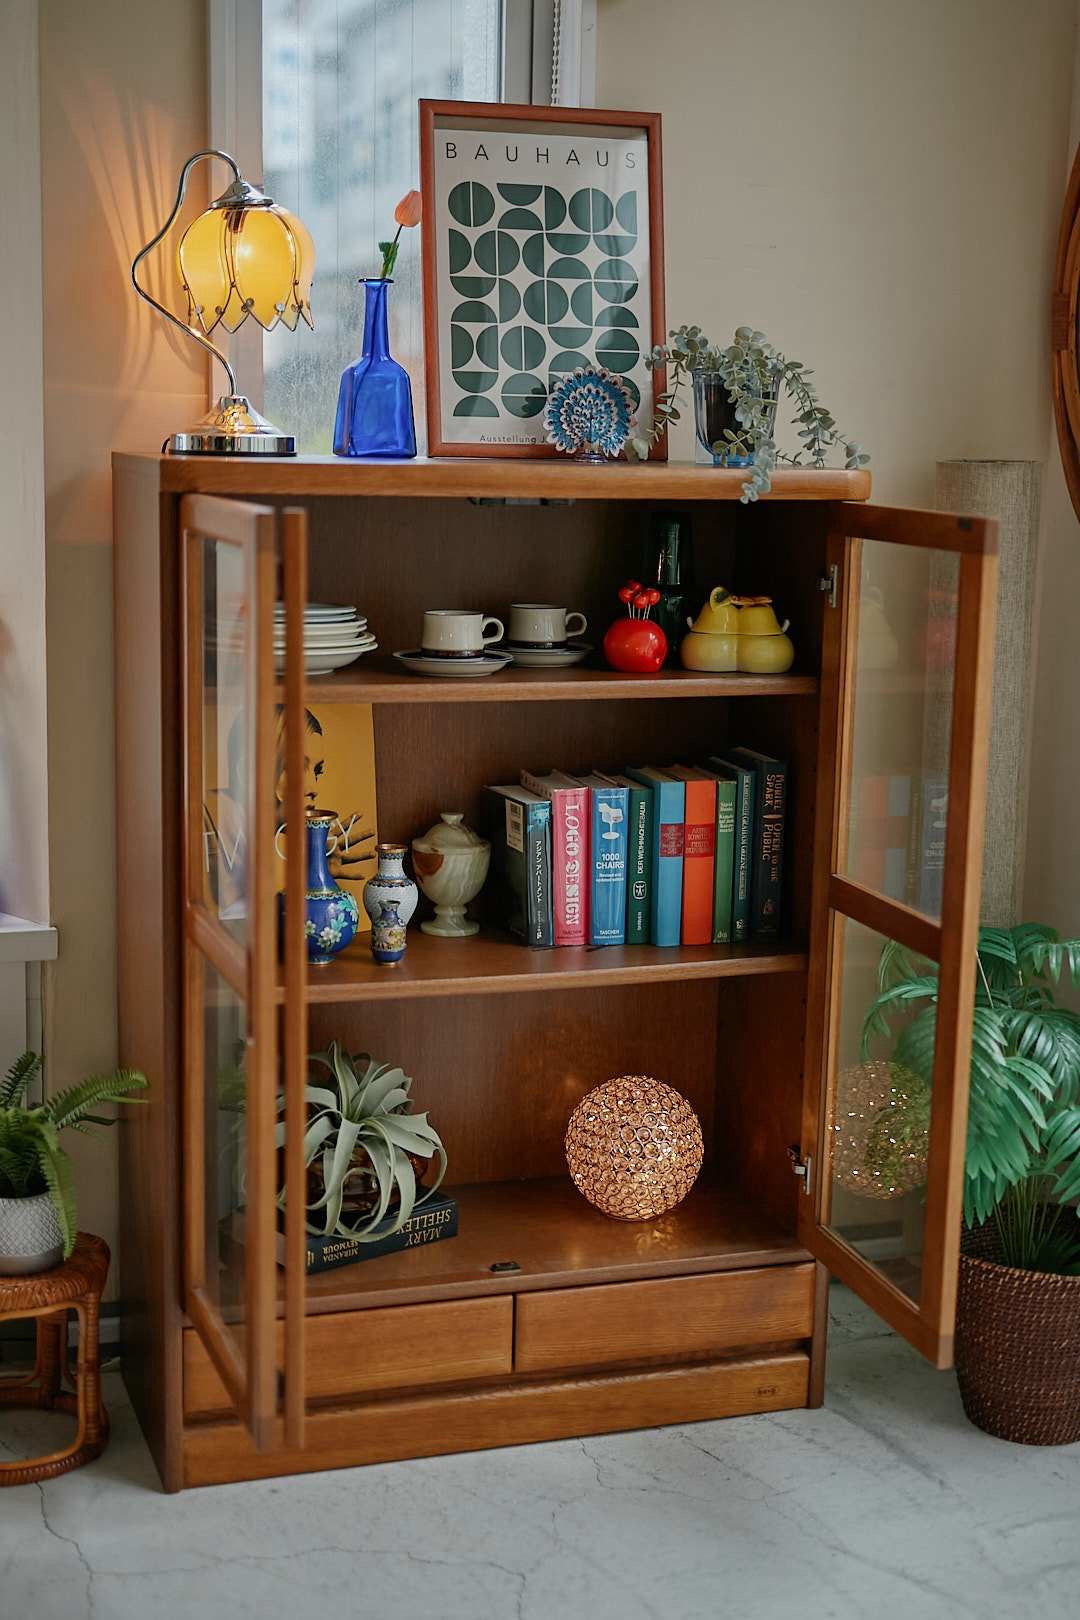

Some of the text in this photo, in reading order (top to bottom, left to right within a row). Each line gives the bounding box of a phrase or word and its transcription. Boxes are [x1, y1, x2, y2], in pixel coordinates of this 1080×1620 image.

[445, 142, 636, 169] BAUHAUS
[480, 434, 537, 444] Ausstellung
[763, 774, 775, 807] SPARK
[773, 774, 785, 810] MURIEL
[565, 803, 580, 857] LOGO
[762, 823, 774, 861] PUBLIC
[596, 861, 625, 870] CHAIRS
[601, 852, 620, 861] 1000
[565, 860, 580, 926] DESIGN
[322, 1240, 359, 1254] SEYMOUR
[404, 1225, 443, 1247] MARY
[322, 1247, 359, 1263] MIRANDA
